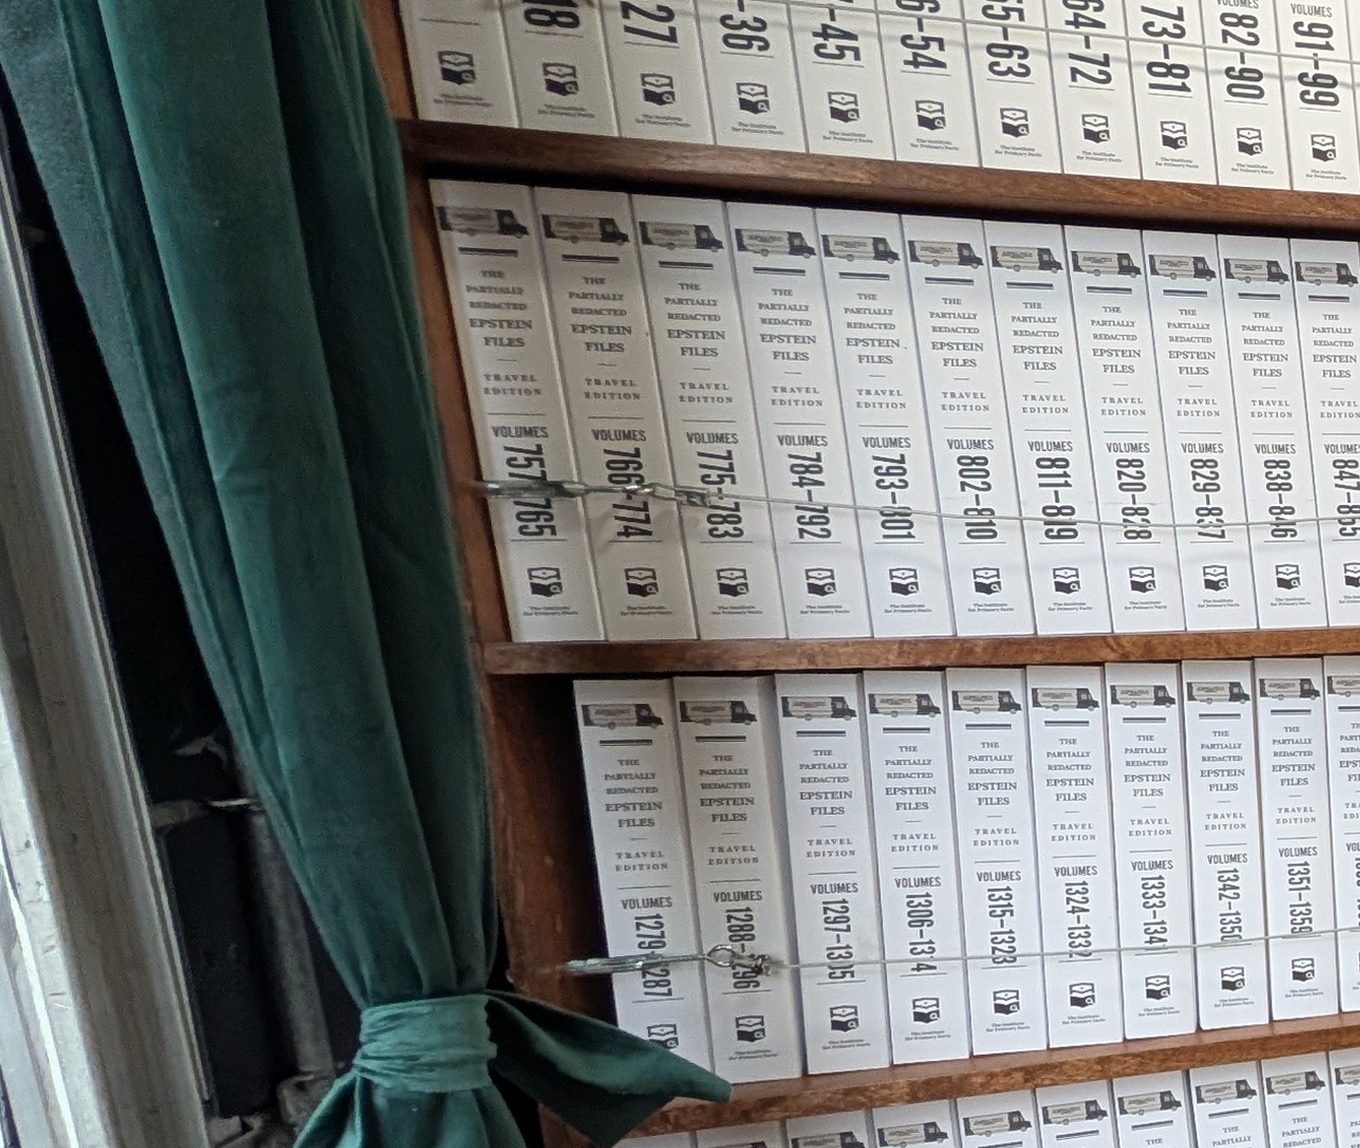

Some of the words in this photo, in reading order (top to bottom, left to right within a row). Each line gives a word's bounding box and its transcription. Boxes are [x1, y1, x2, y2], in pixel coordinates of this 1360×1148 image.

[1290, 3, 1333, 19] VOLUMES
[1138, 4, 1192, 98] 73-81
[1217, 12, 1268, 102] 82-90
[1292, 21, 1342, 108] 91-99
[771, 287, 795, 298] THE
[757, 301, 811, 313] PARTIALLY
[759, 316, 814, 328] REDACTED
[759, 332, 818, 347] EPSTEIN
[771, 350, 811, 363] FILES
[771, 383, 821, 398] TRAVEL
[770, 398, 824, 409] EDITION
[777, 433, 829, 449] VOLUMES
[785, 451, 835, 541] 784-792
[981, 741, 1001, 750] THE
[967, 752, 1015, 763] PARTIALLY
[968, 765, 1017, 776] REDACTED
[967, 780, 1018, 793] EPSTEIN
[977, 795, 1011, 808] FILES
[974, 826, 1018, 837] TRAVEL
[973, 836, 1021, 848] EDITION
[976, 870, 1022, 884] VOLUMES
[986, 886, 1017, 967] 1315-1323
[1222, 1125, 1240, 1134] THE
[1212, 1135, 1253, 1148] PARTIALLY
